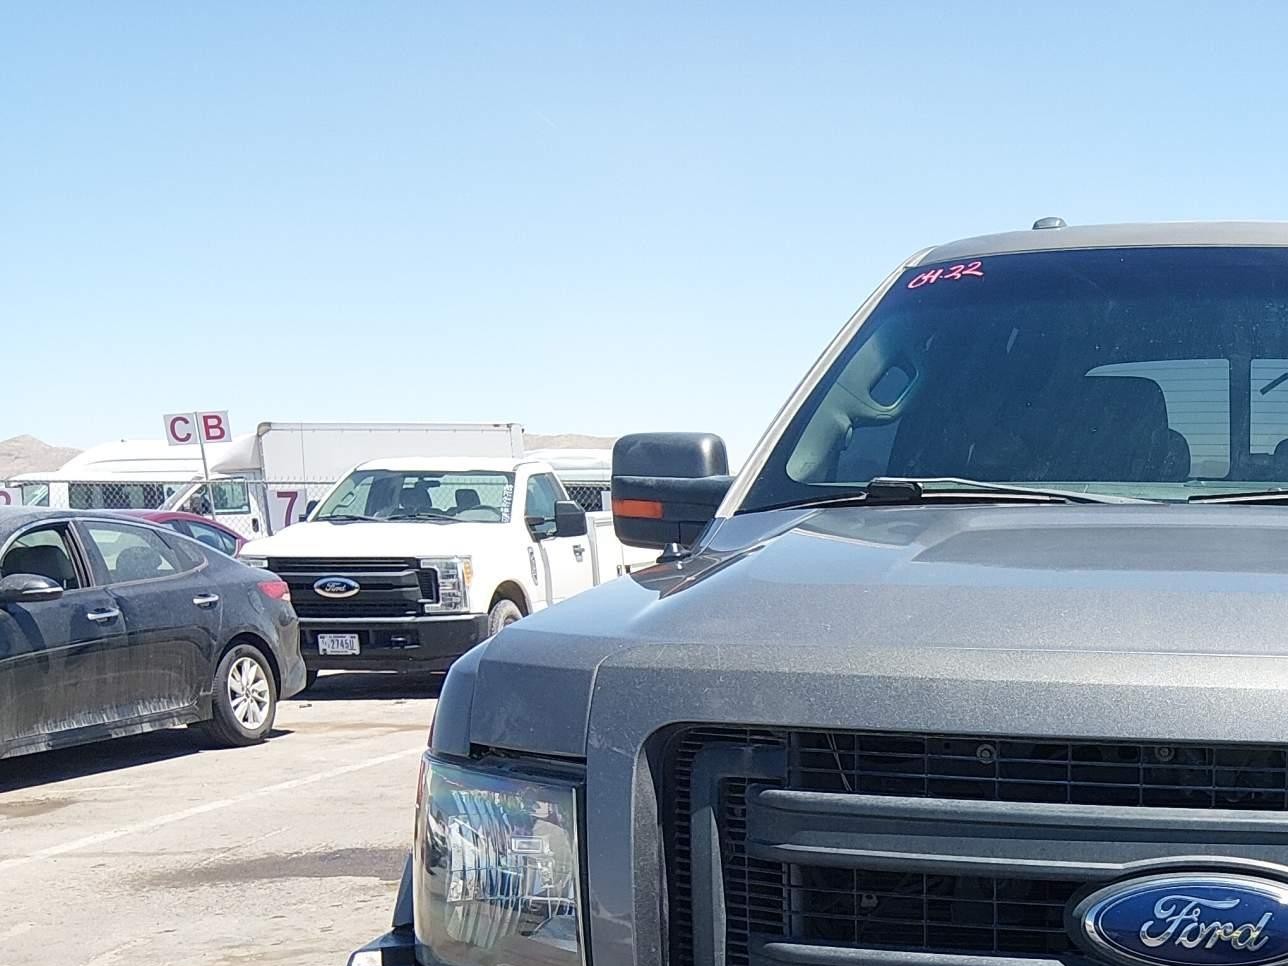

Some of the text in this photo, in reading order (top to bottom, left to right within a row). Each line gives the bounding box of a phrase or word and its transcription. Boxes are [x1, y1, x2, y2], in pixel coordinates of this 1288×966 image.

[169, 416, 192, 442] C
[203, 415, 226, 441] B
[276, 491, 298, 528] 7
[1139, 895, 1273, 951] Ford
